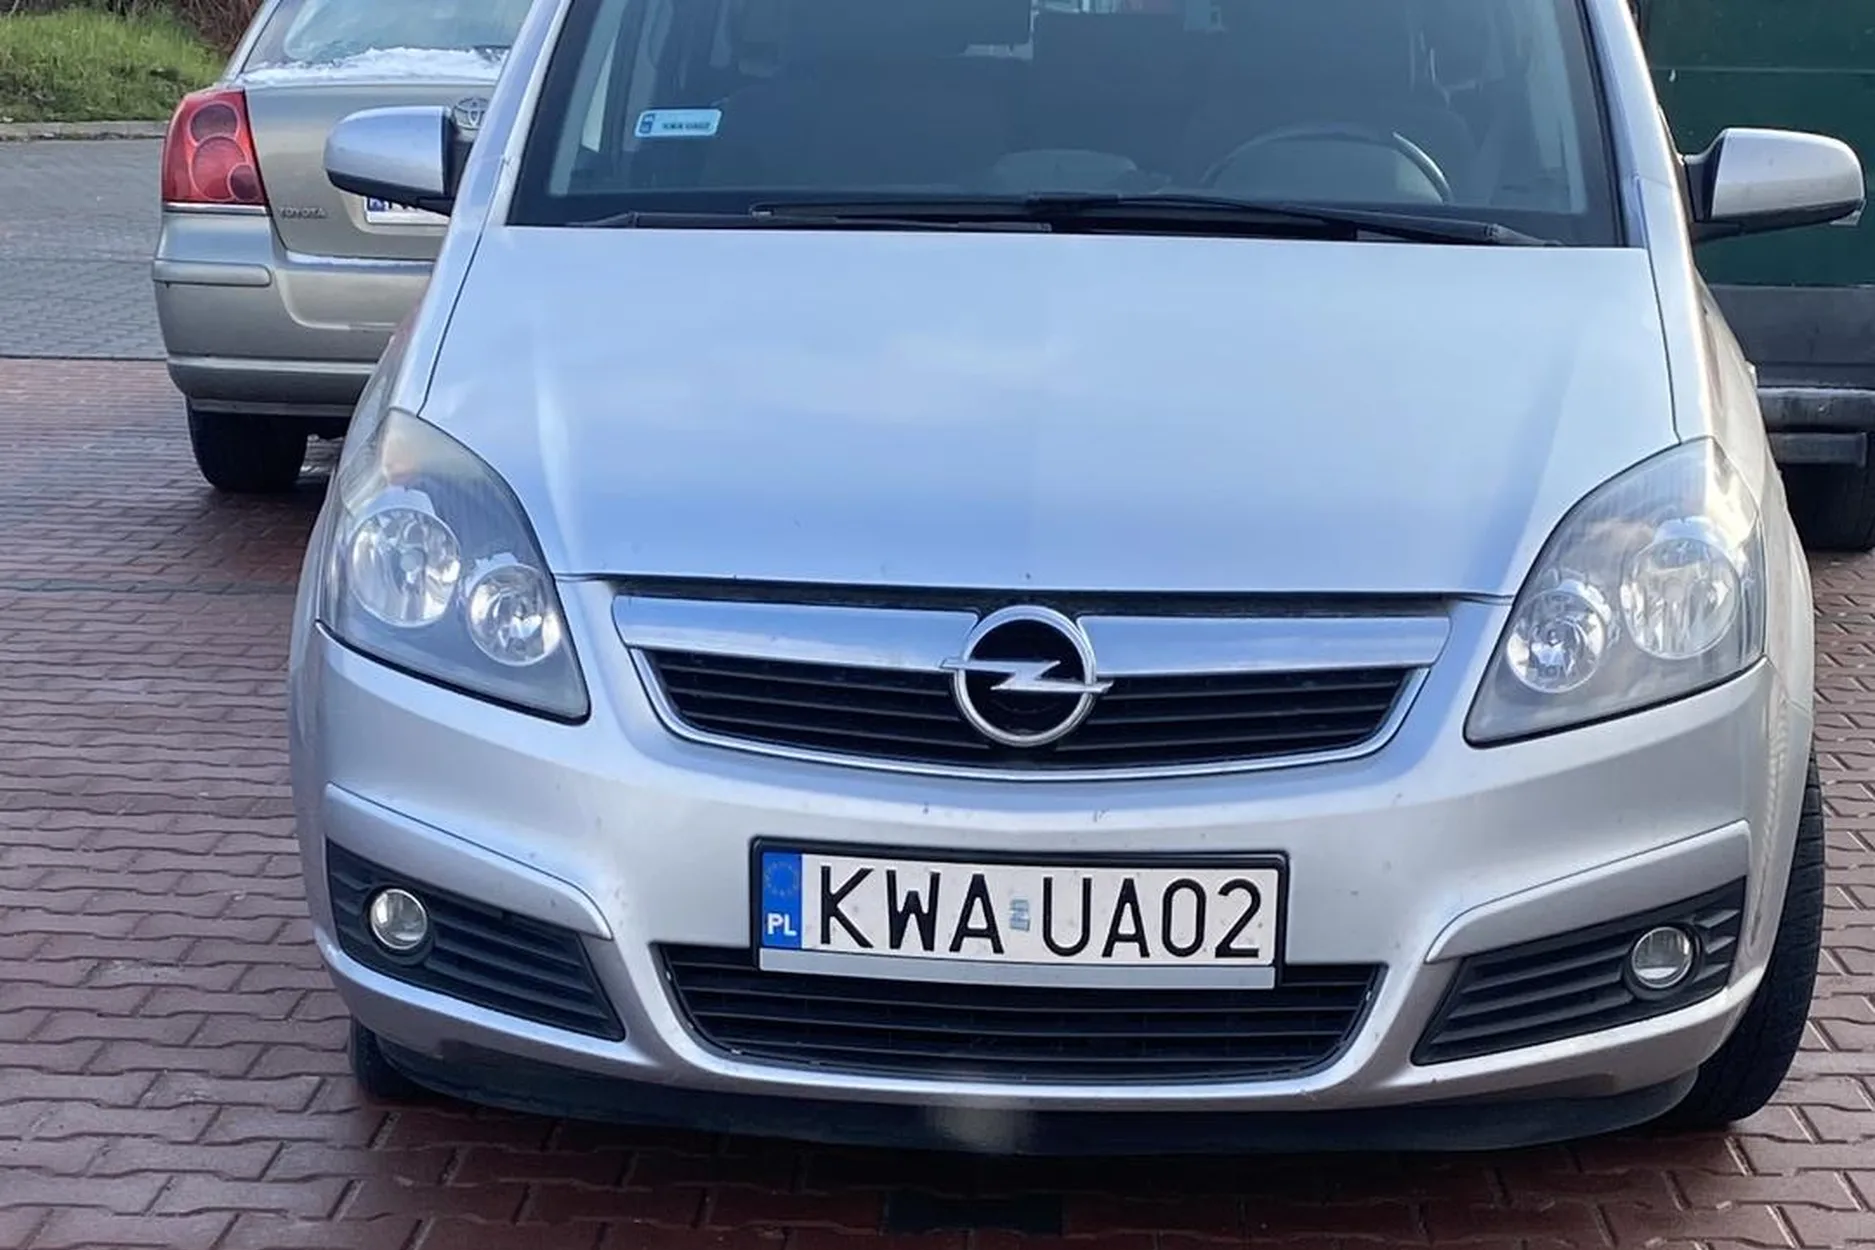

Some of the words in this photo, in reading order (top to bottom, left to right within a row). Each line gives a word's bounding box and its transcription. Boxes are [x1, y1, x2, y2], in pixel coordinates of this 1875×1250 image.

[279, 206, 328, 219] TOYOTA
[767, 912, 797, 936] PL
[820, 865, 1005, 955] KWA
[1042, 876, 1262, 959] UA02
